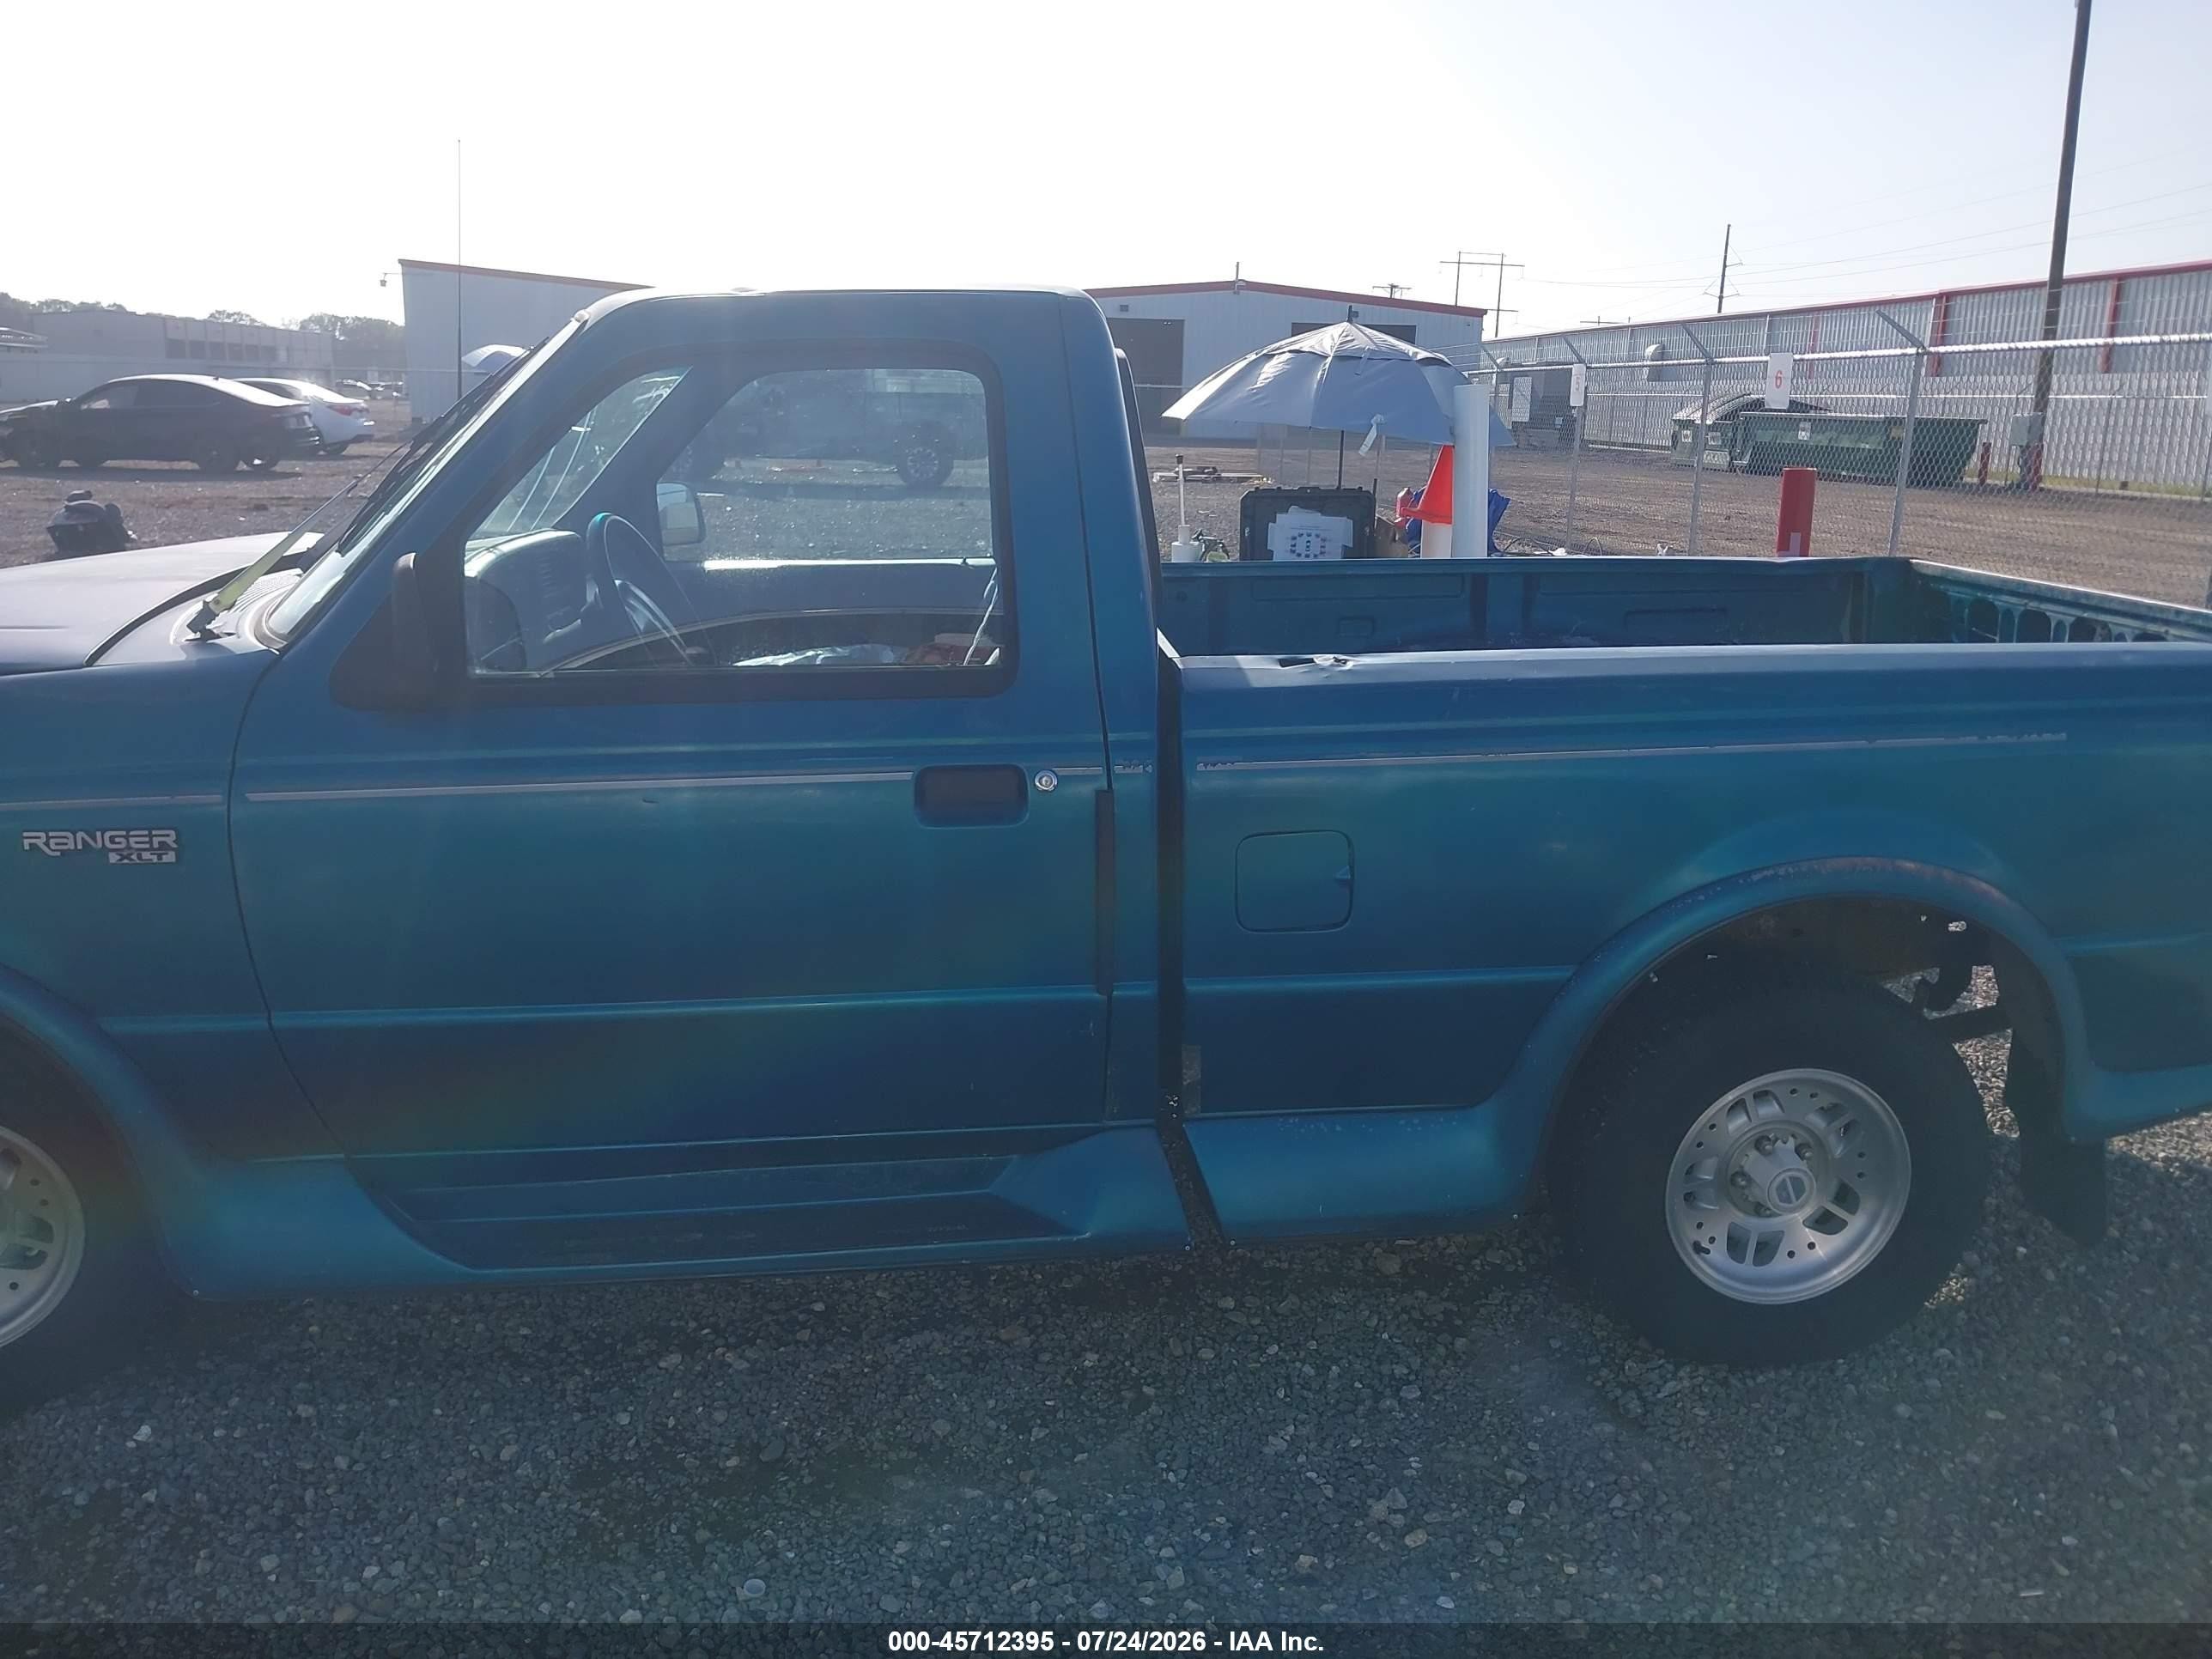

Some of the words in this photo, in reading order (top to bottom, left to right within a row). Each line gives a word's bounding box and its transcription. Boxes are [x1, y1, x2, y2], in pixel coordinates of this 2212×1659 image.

[1775, 369, 1783, 389] 6
[22, 830, 179, 857] RANGER
[115, 852, 169, 863] XLT
